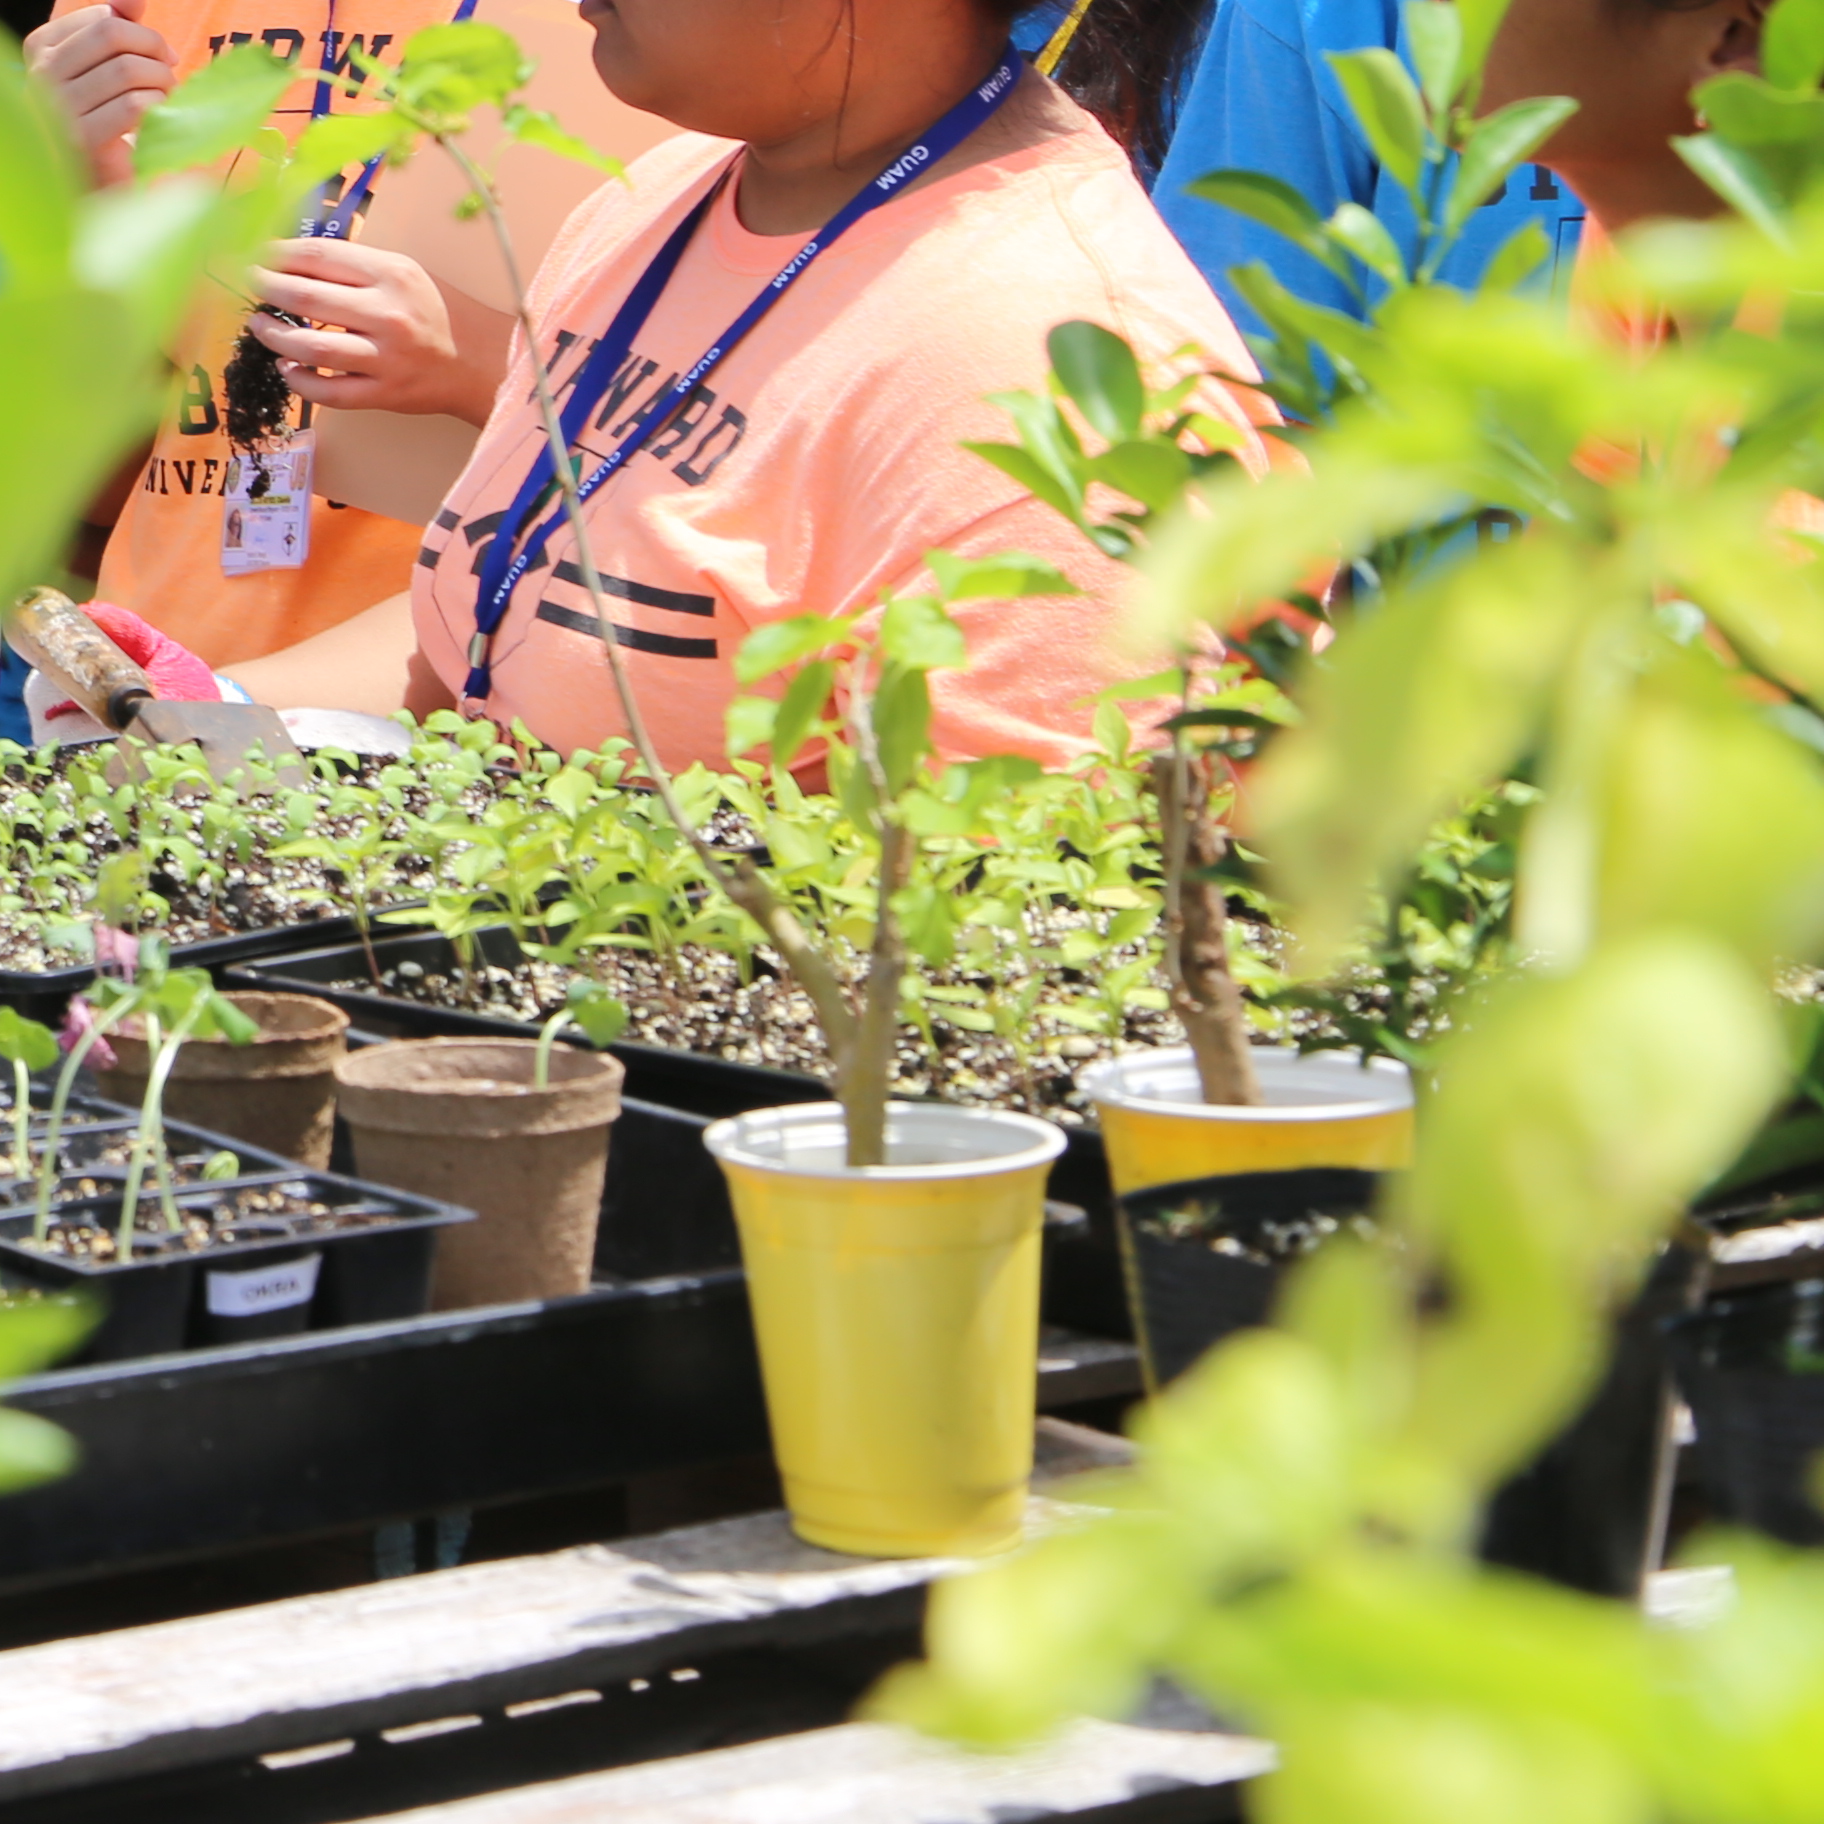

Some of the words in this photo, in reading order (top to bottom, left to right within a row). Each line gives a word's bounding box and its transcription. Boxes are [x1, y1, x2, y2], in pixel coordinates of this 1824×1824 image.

[977, 65, 1013, 103] GUAM
[875, 145, 930, 190] GUAM
[772, 241, 818, 289] GUAM
[675, 347, 721, 394] GUAM
[577, 451, 622, 496] GUAM
[492, 554, 528, 604] GUAM
